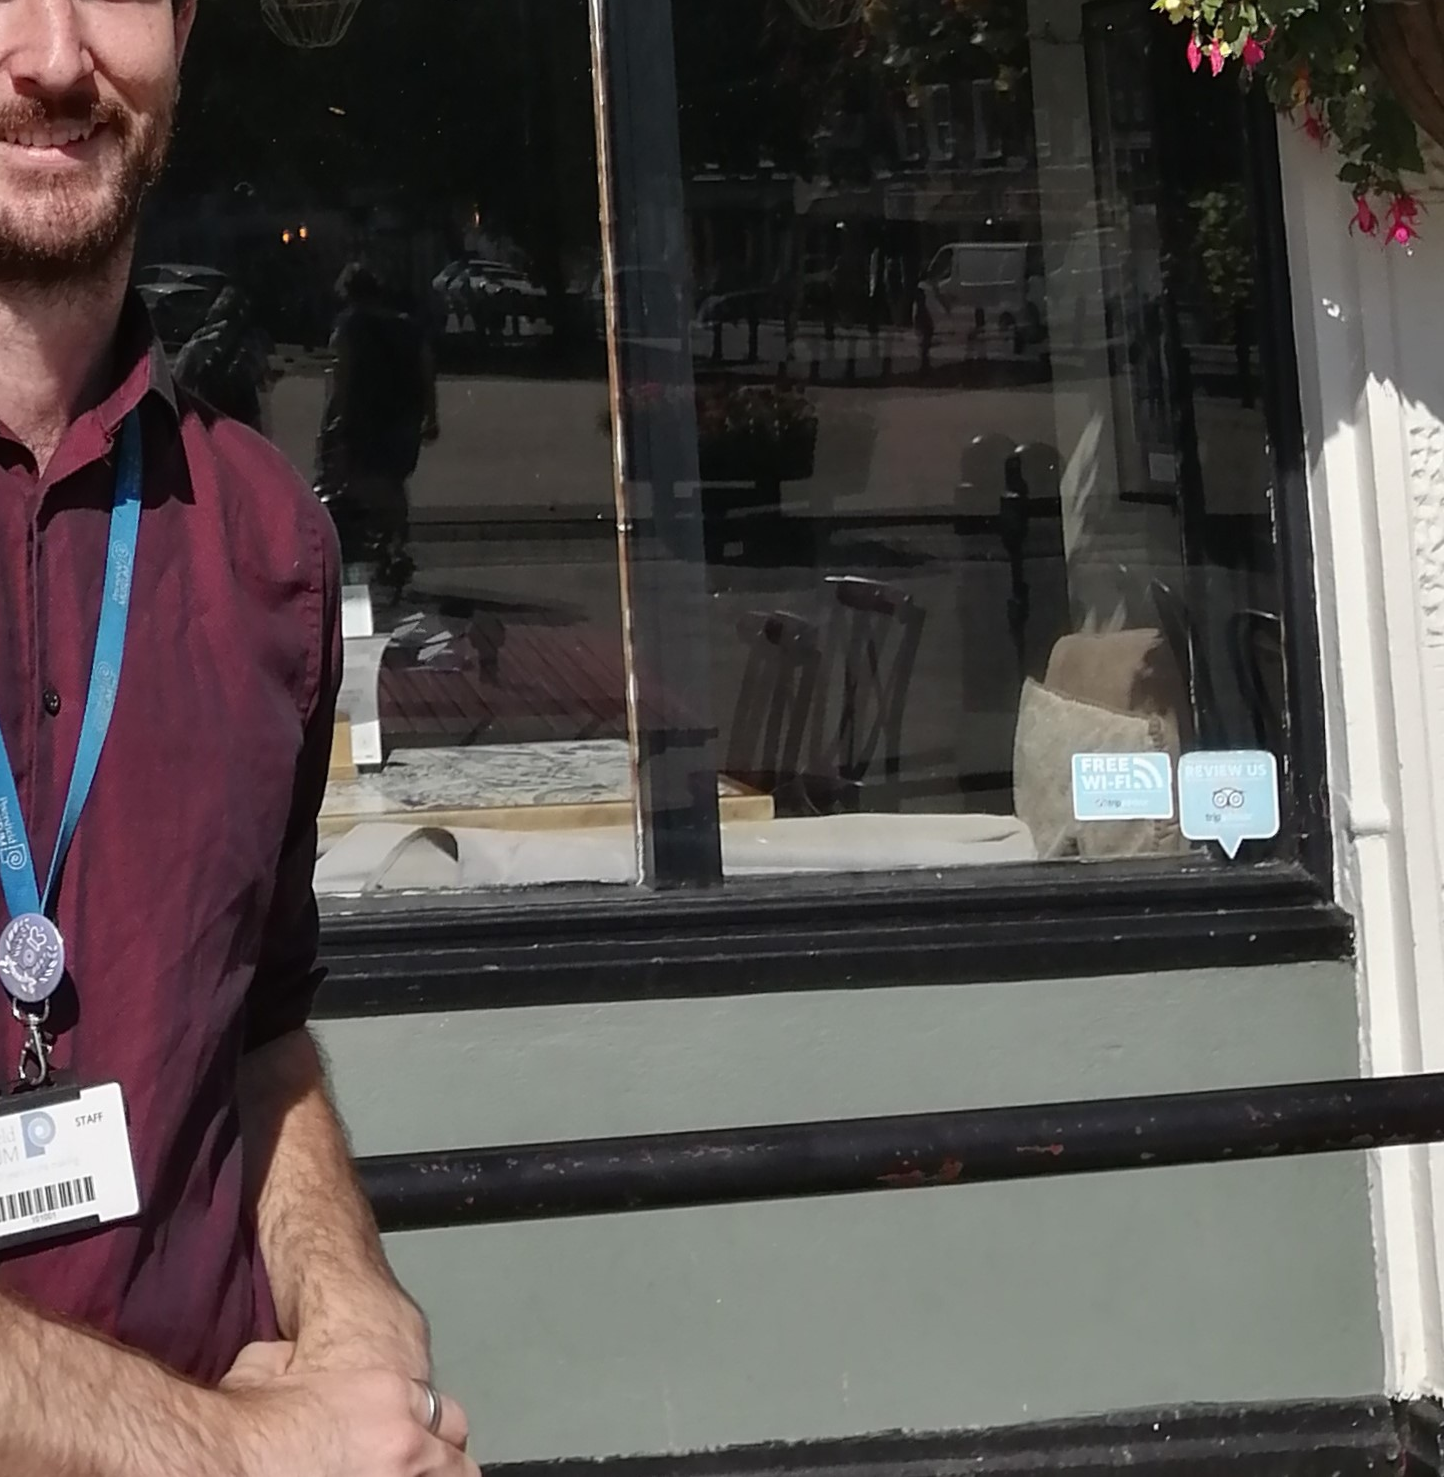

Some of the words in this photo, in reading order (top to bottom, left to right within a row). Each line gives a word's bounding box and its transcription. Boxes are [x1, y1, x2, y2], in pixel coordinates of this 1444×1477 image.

[1081, 757, 1130, 773] FREE
[1184, 763, 1242, 779] REVIEW
[1247, 763, 1268, 776] US
[1081, 774, 1131, 790] WI-FI
[75, 1112, 103, 1127] STAFF
